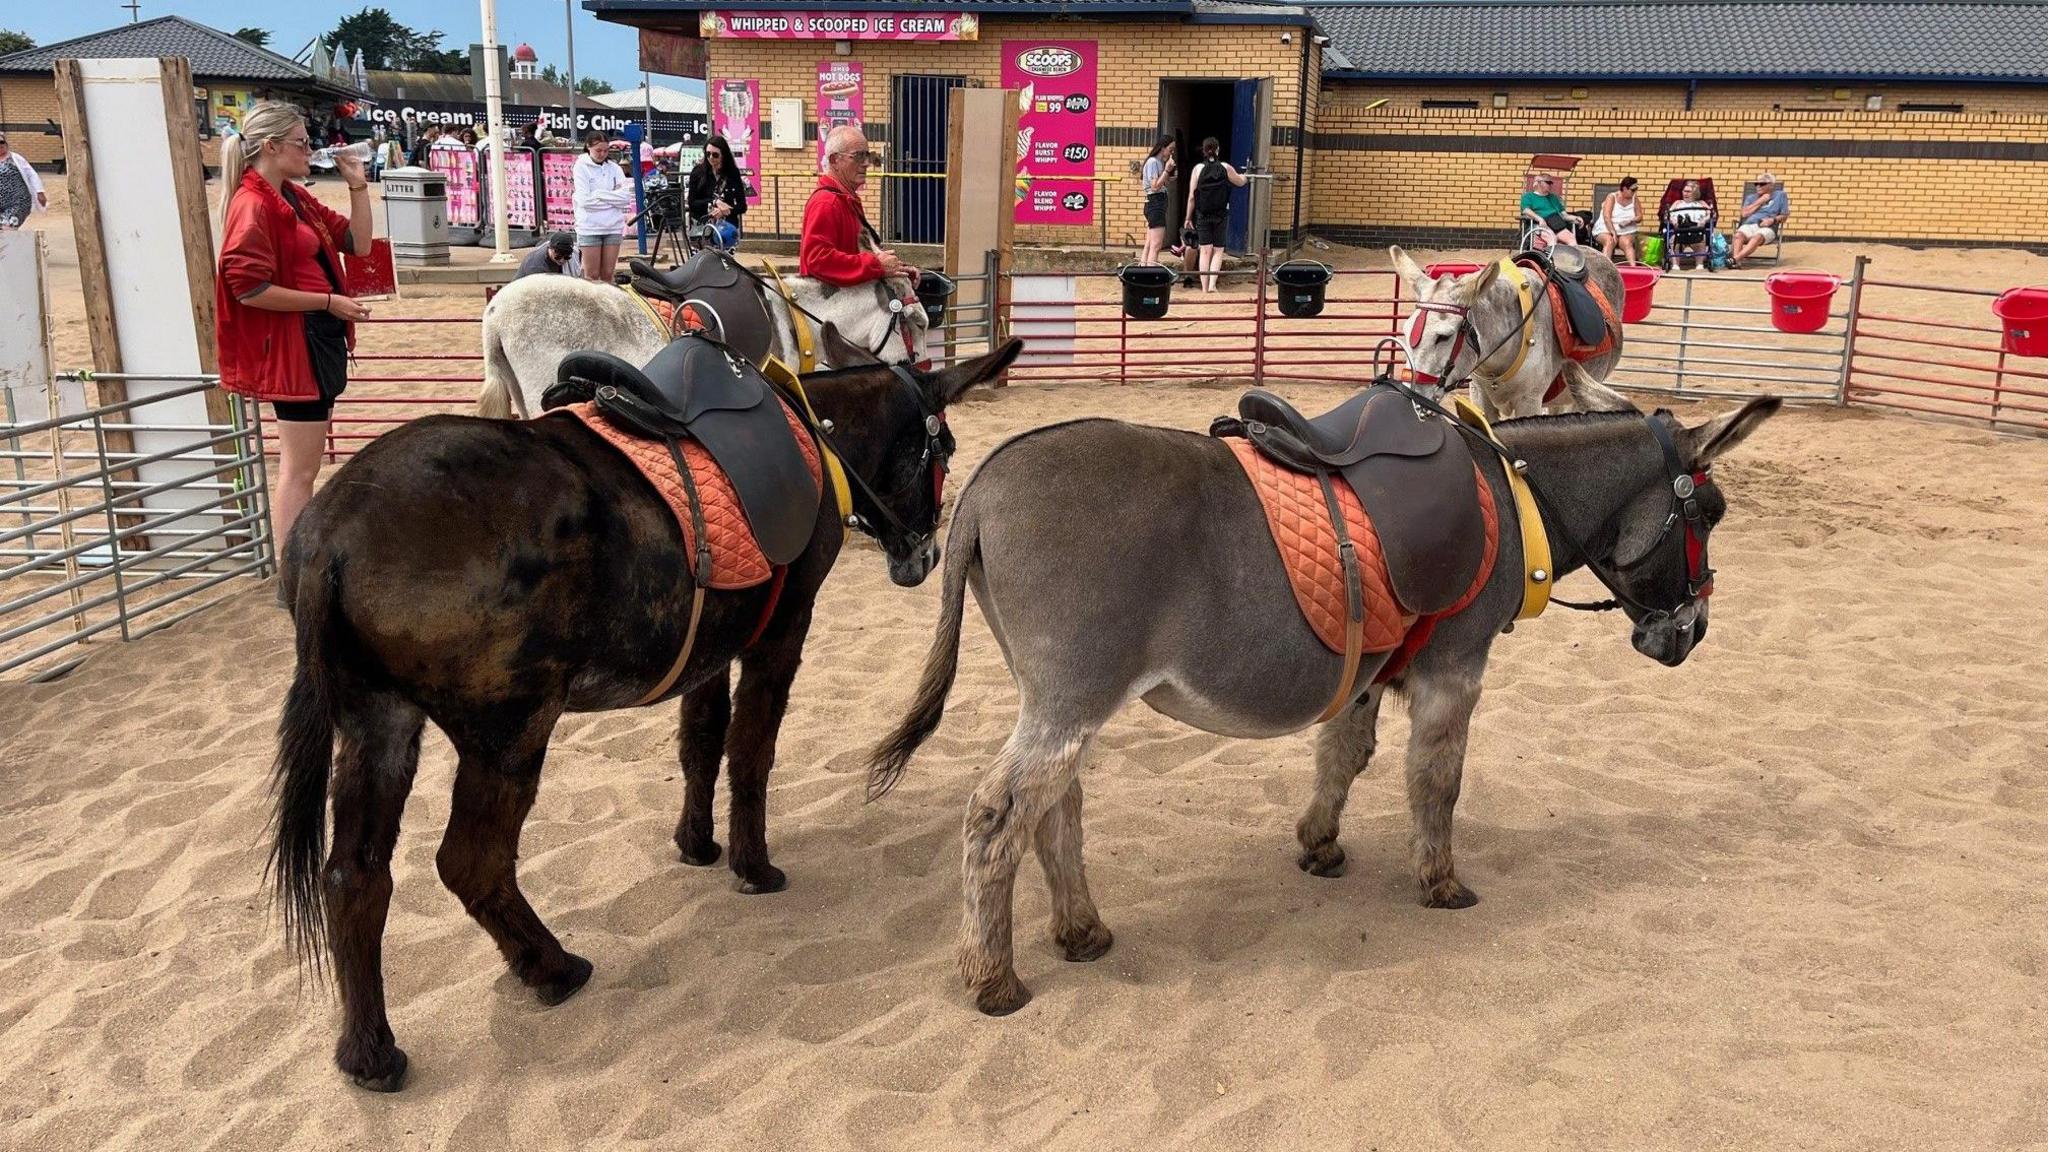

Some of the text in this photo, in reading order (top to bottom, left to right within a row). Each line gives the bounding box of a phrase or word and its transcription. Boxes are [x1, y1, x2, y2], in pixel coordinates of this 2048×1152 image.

[730, 17, 945, 32] WHIPPED & SCOOPED ICE CREAM
[1026, 54, 1072, 66] SCOOPS
[819, 72, 861, 82] HOT DOGS
[1049, 102, 1061, 113] 99
[401, 107, 473, 125] Cream
[542, 113, 571, 129] Fish
[576, 115, 588, 129] &
